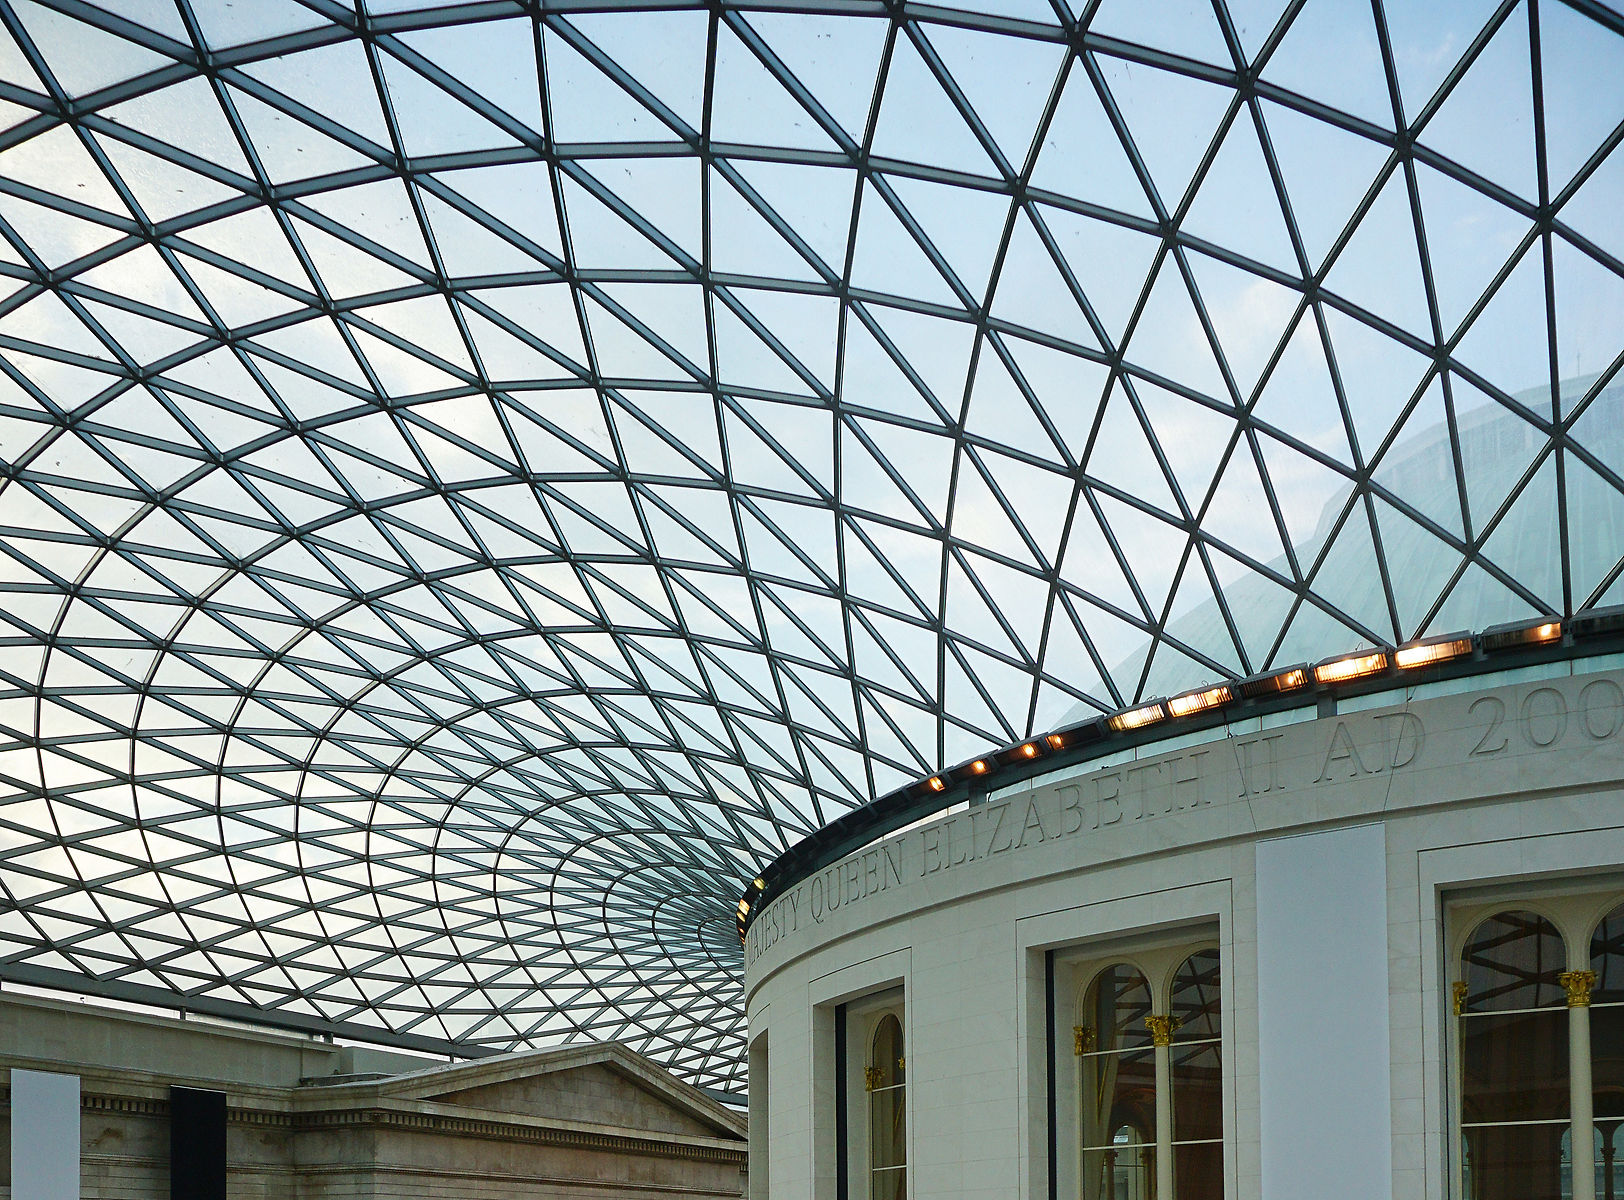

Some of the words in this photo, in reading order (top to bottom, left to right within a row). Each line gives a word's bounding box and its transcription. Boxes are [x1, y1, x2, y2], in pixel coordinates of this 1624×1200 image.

[810, 838, 906, 925] QUEEN
[919, 750, 1211, 877] ELIZABETH
[1237, 735, 1286, 798] II
[1312, 711, 1426, 784] AD
